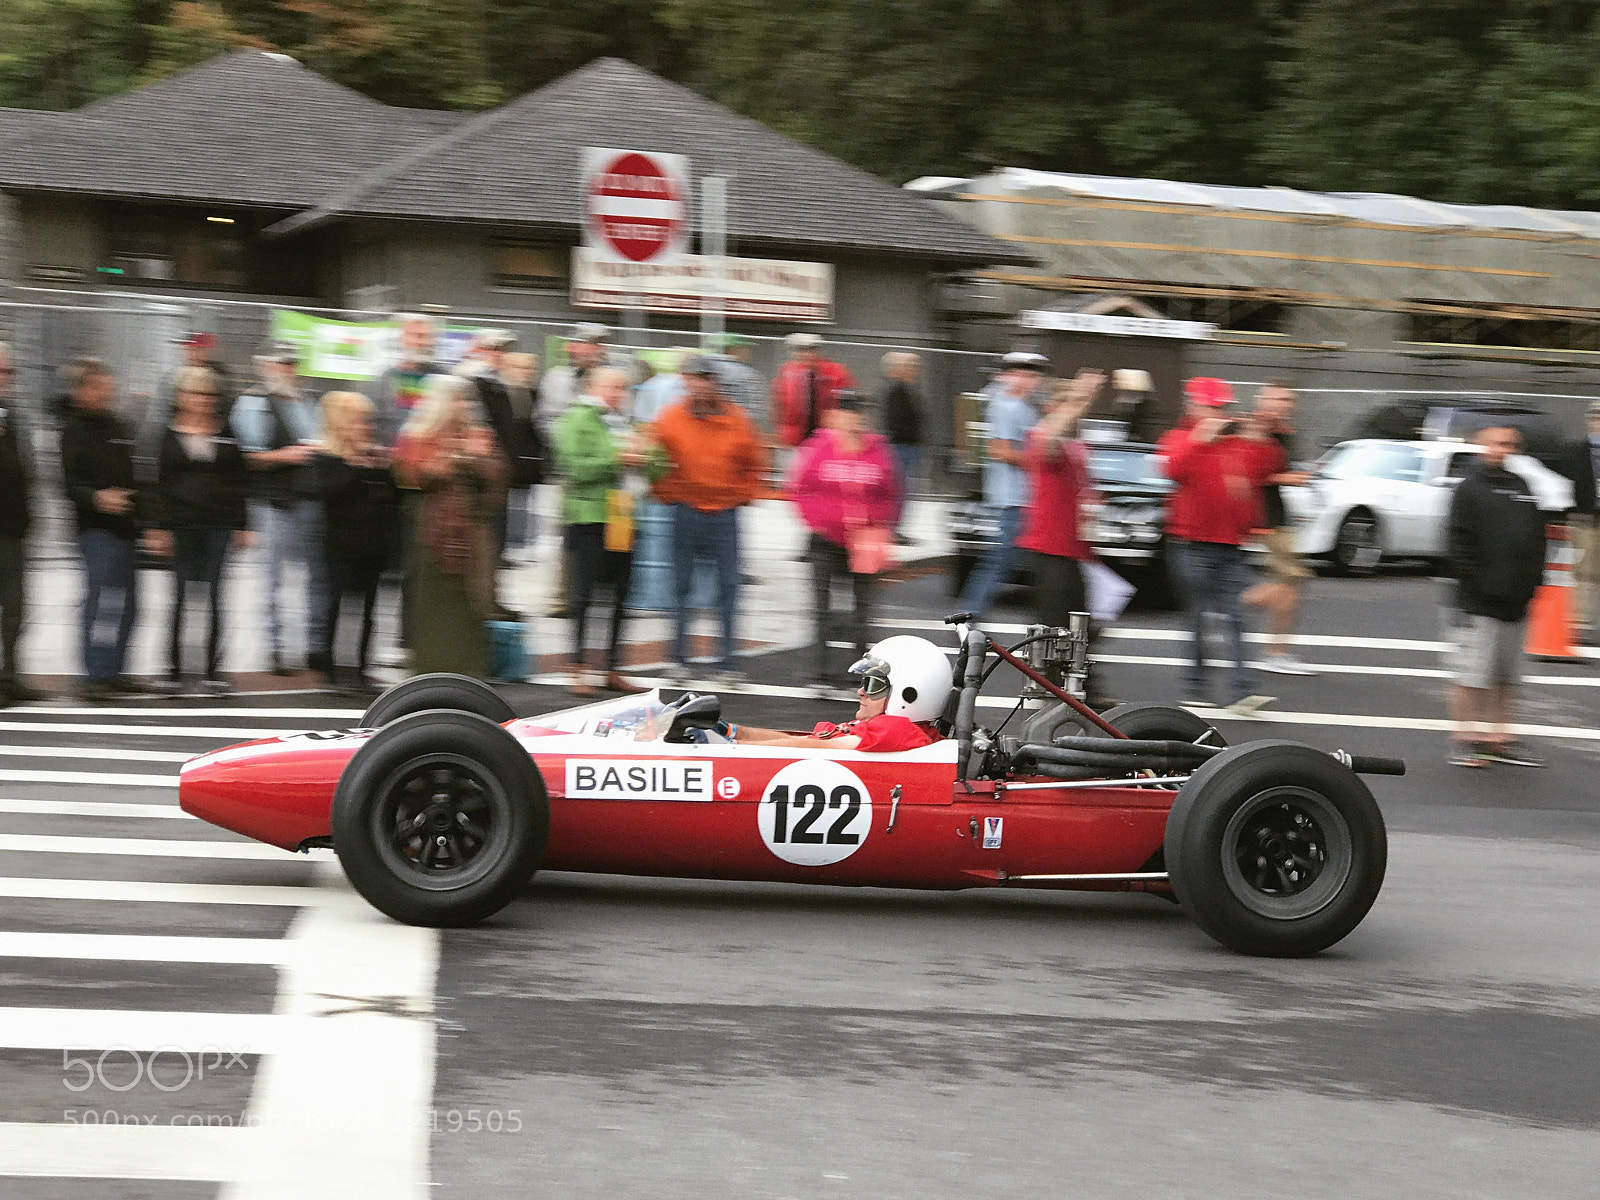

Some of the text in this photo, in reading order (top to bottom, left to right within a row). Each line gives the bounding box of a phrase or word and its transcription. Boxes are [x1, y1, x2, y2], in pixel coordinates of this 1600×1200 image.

[575, 765, 703, 794] BASILE
[722, 778, 736, 797] E
[769, 784, 862, 846] 122
